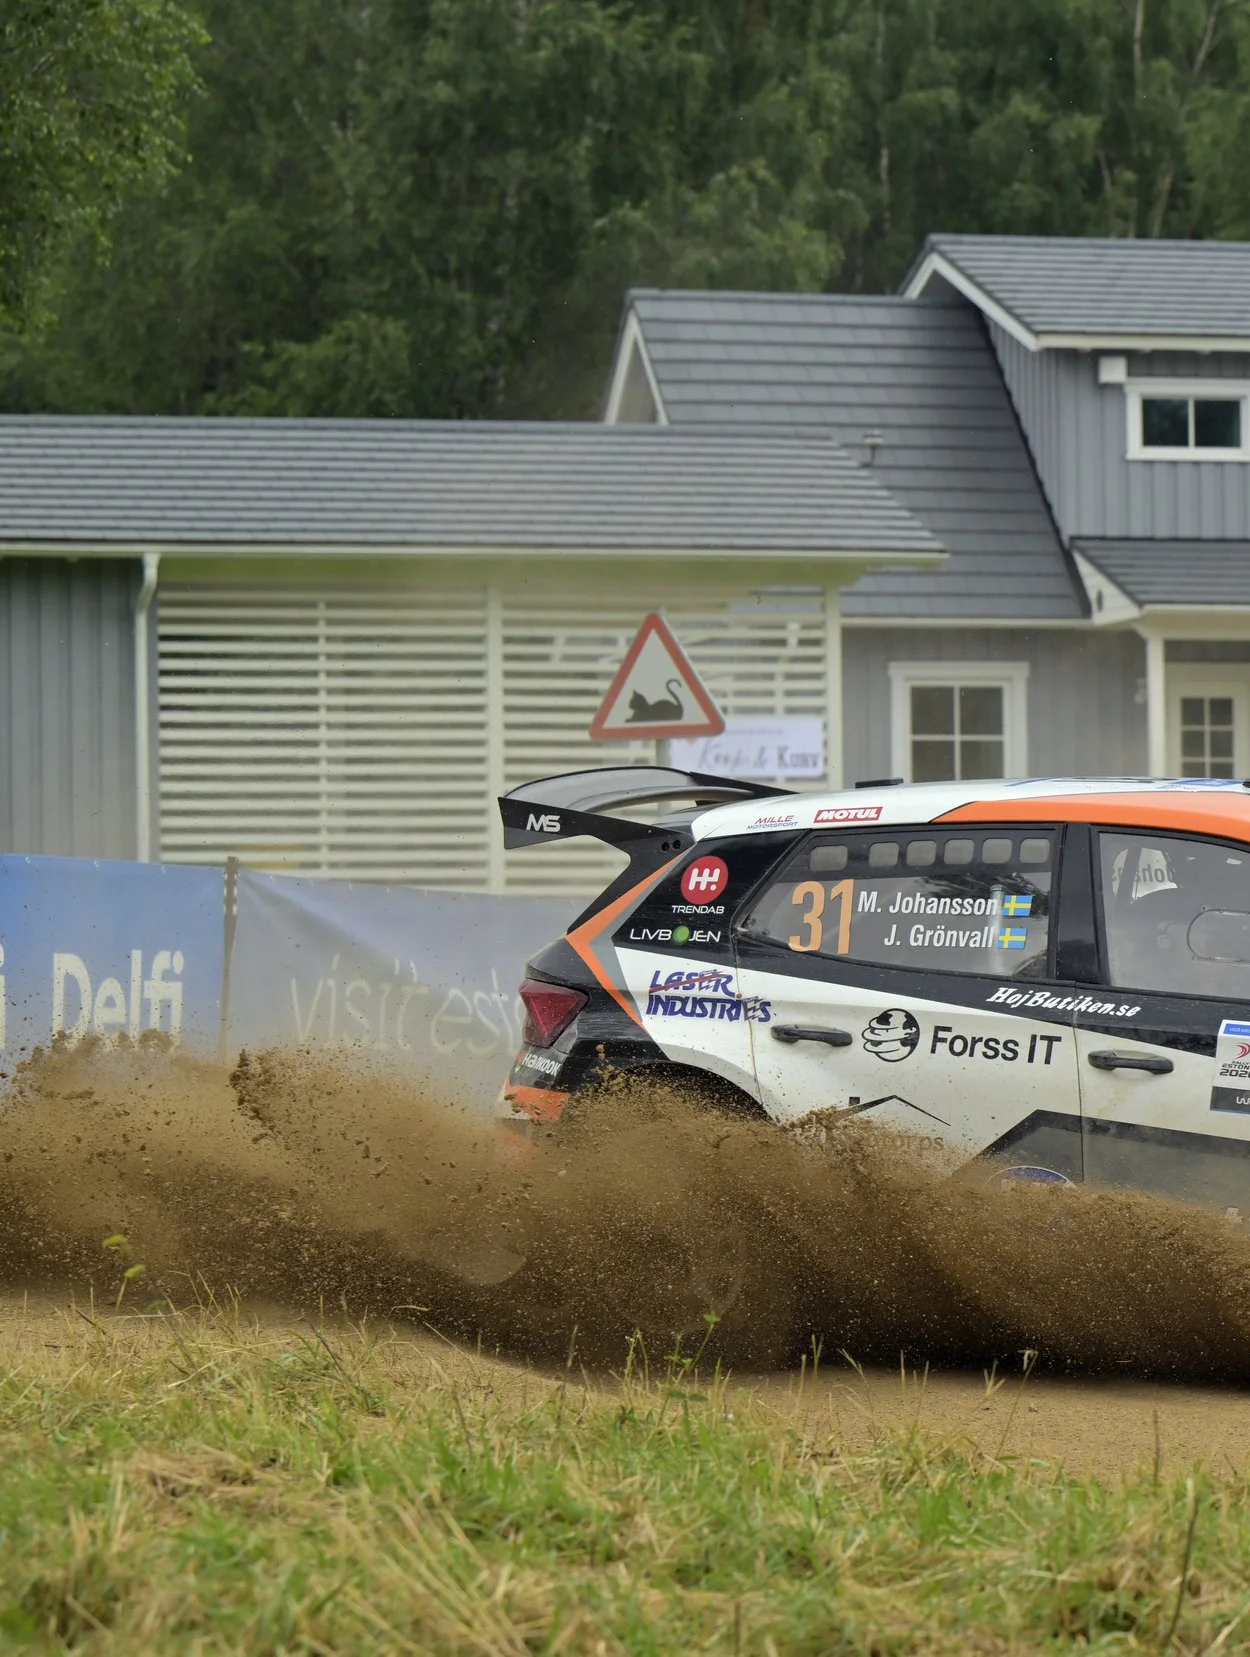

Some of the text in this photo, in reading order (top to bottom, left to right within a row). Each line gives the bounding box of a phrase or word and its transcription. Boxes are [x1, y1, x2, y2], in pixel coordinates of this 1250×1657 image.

[526, 813, 561, 833] MS
[747, 821, 798, 830] MOTORSPORT
[755, 815, 794, 824] MILLE
[815, 808, 879, 821] MOTUL
[671, 904, 725, 915] TRENDAB
[858, 891, 998, 916] M. Johansson
[788, 879, 855, 955] 31
[884, 923, 995, 948] J. Grönvall
[650, 969, 736, 998] LASER
[52, 949, 184, 1052] Delfi
[290, 952, 430, 1050] visit
[646, 995, 771, 1022] INDUSTRIES
[985, 987, 1141, 1017] HojButiken.se
[930, 1025, 1062, 1065] Forss IT
